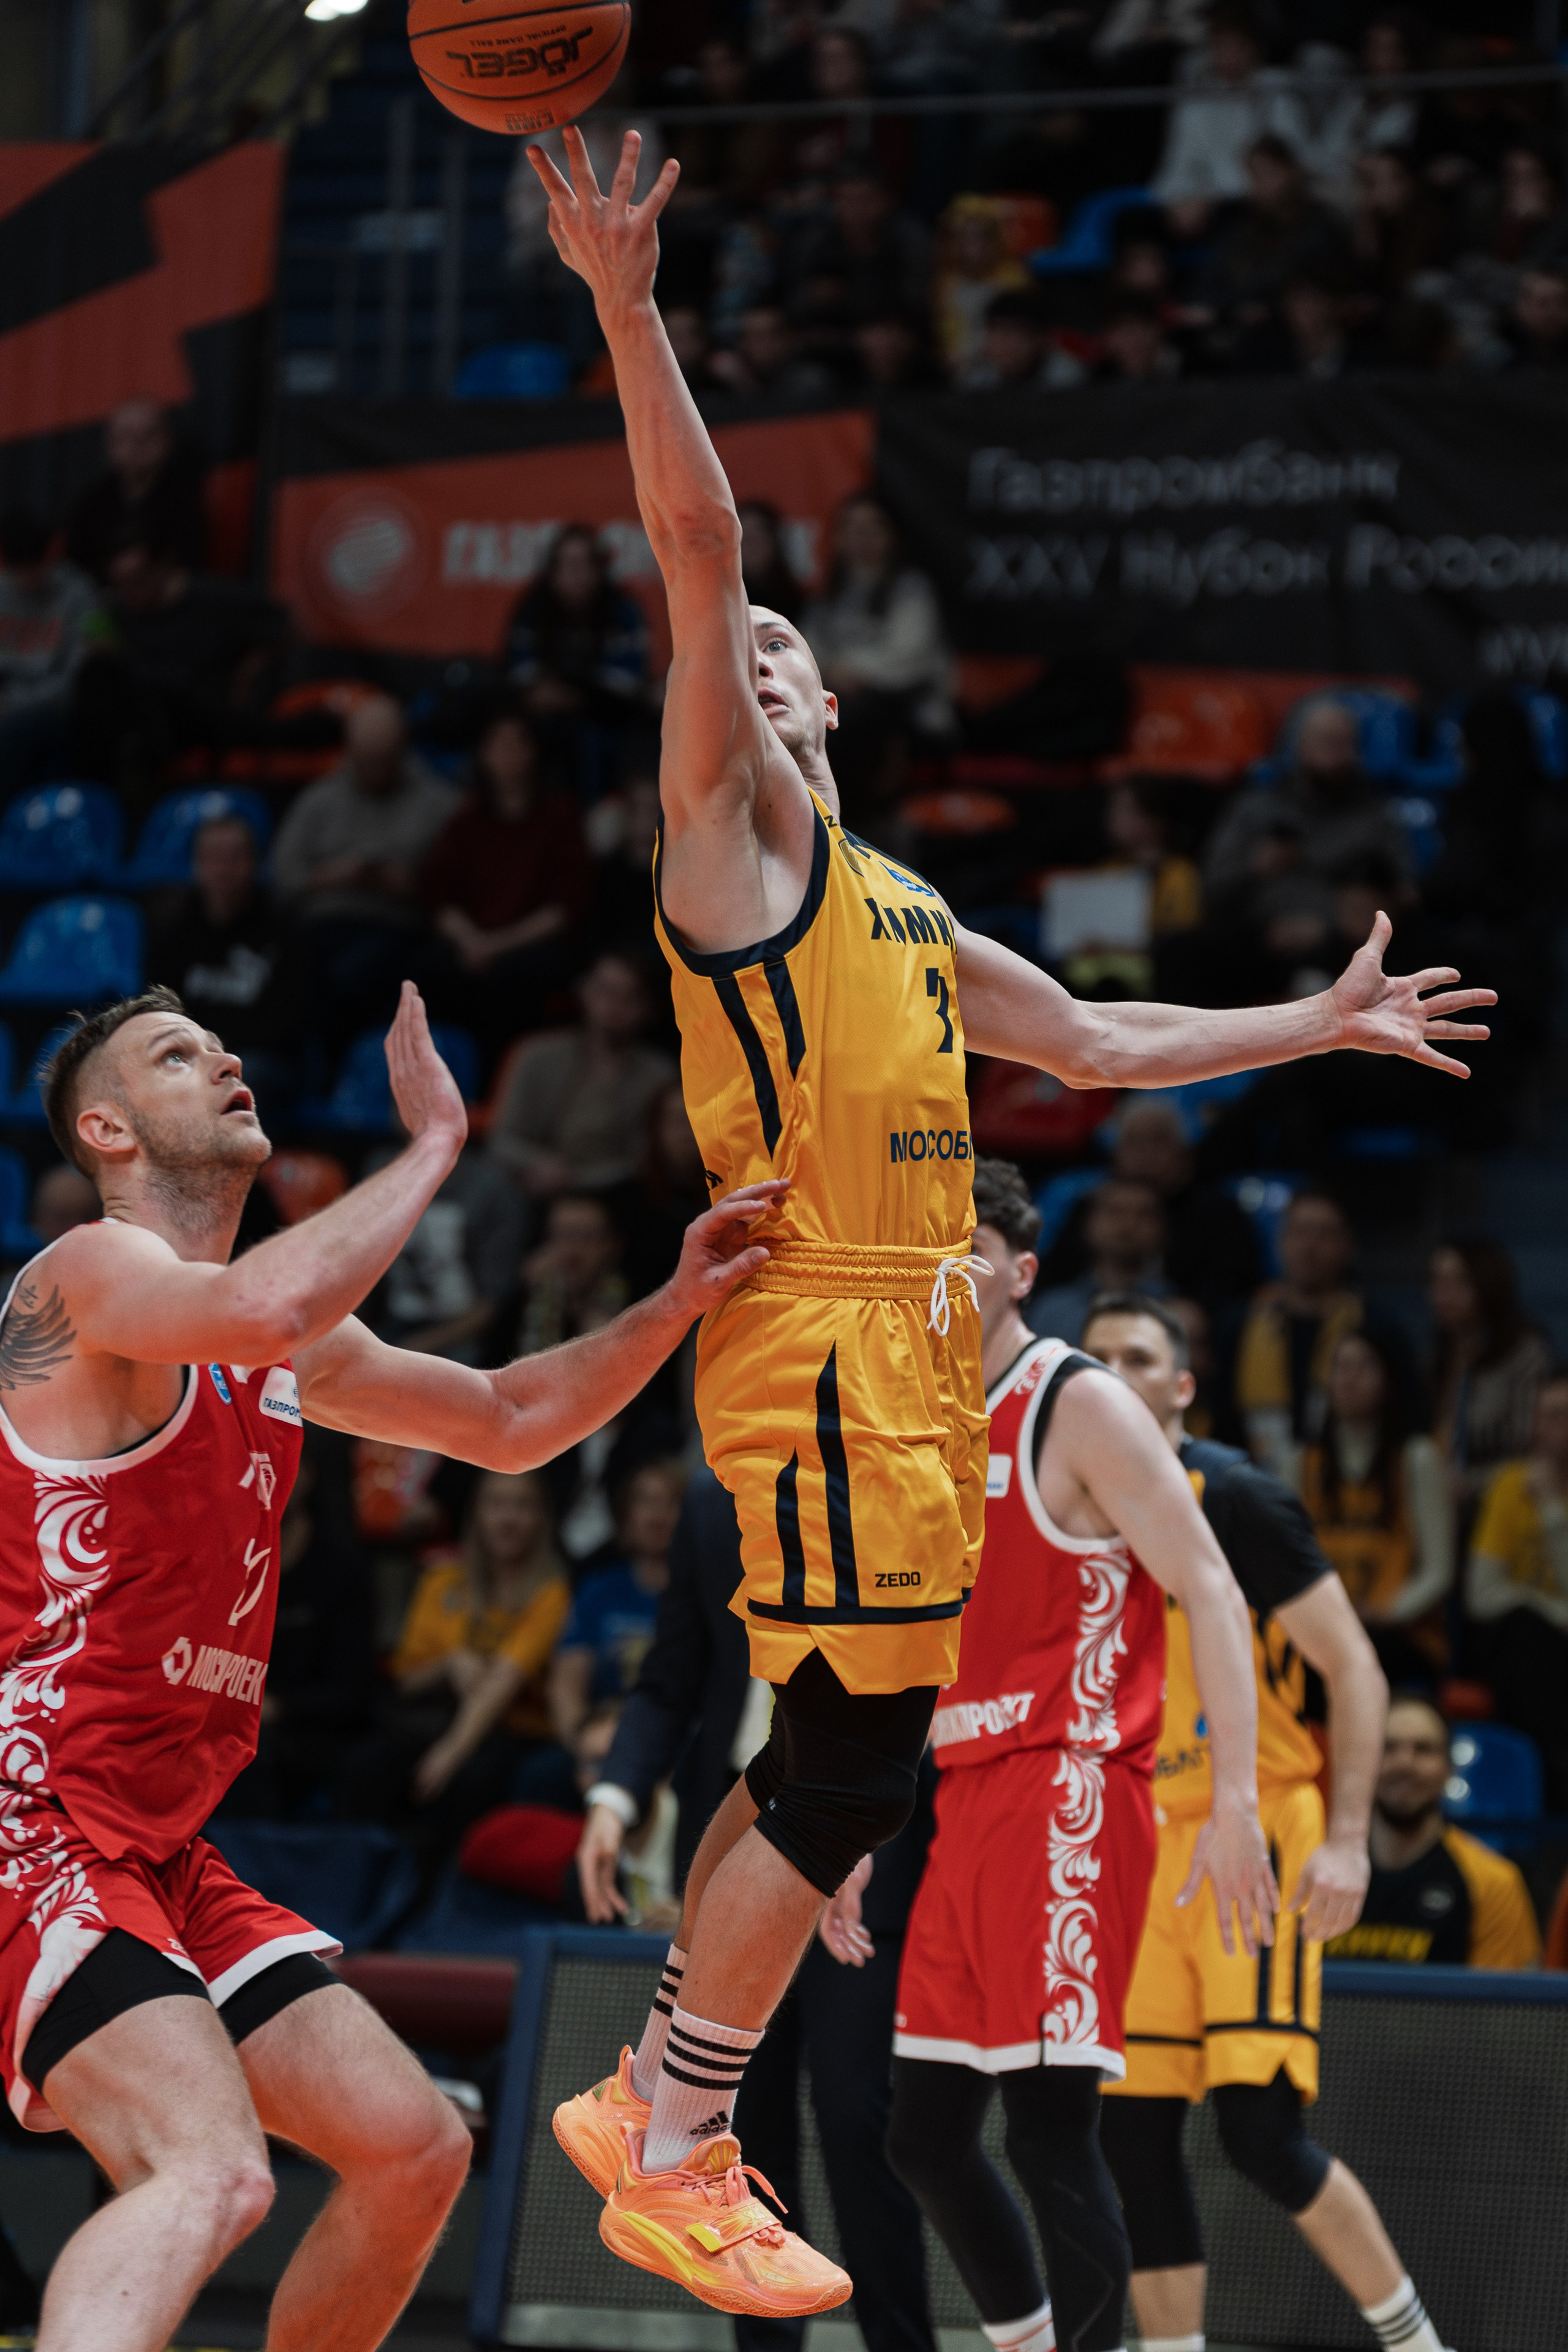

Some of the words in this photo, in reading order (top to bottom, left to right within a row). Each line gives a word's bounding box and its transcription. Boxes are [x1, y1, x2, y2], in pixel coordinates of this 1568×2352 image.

[445, 26, 594, 78] JÖGEL
[864, 897, 958, 956] ХИМК
[875, 1571, 921, 1588] ZEDO
